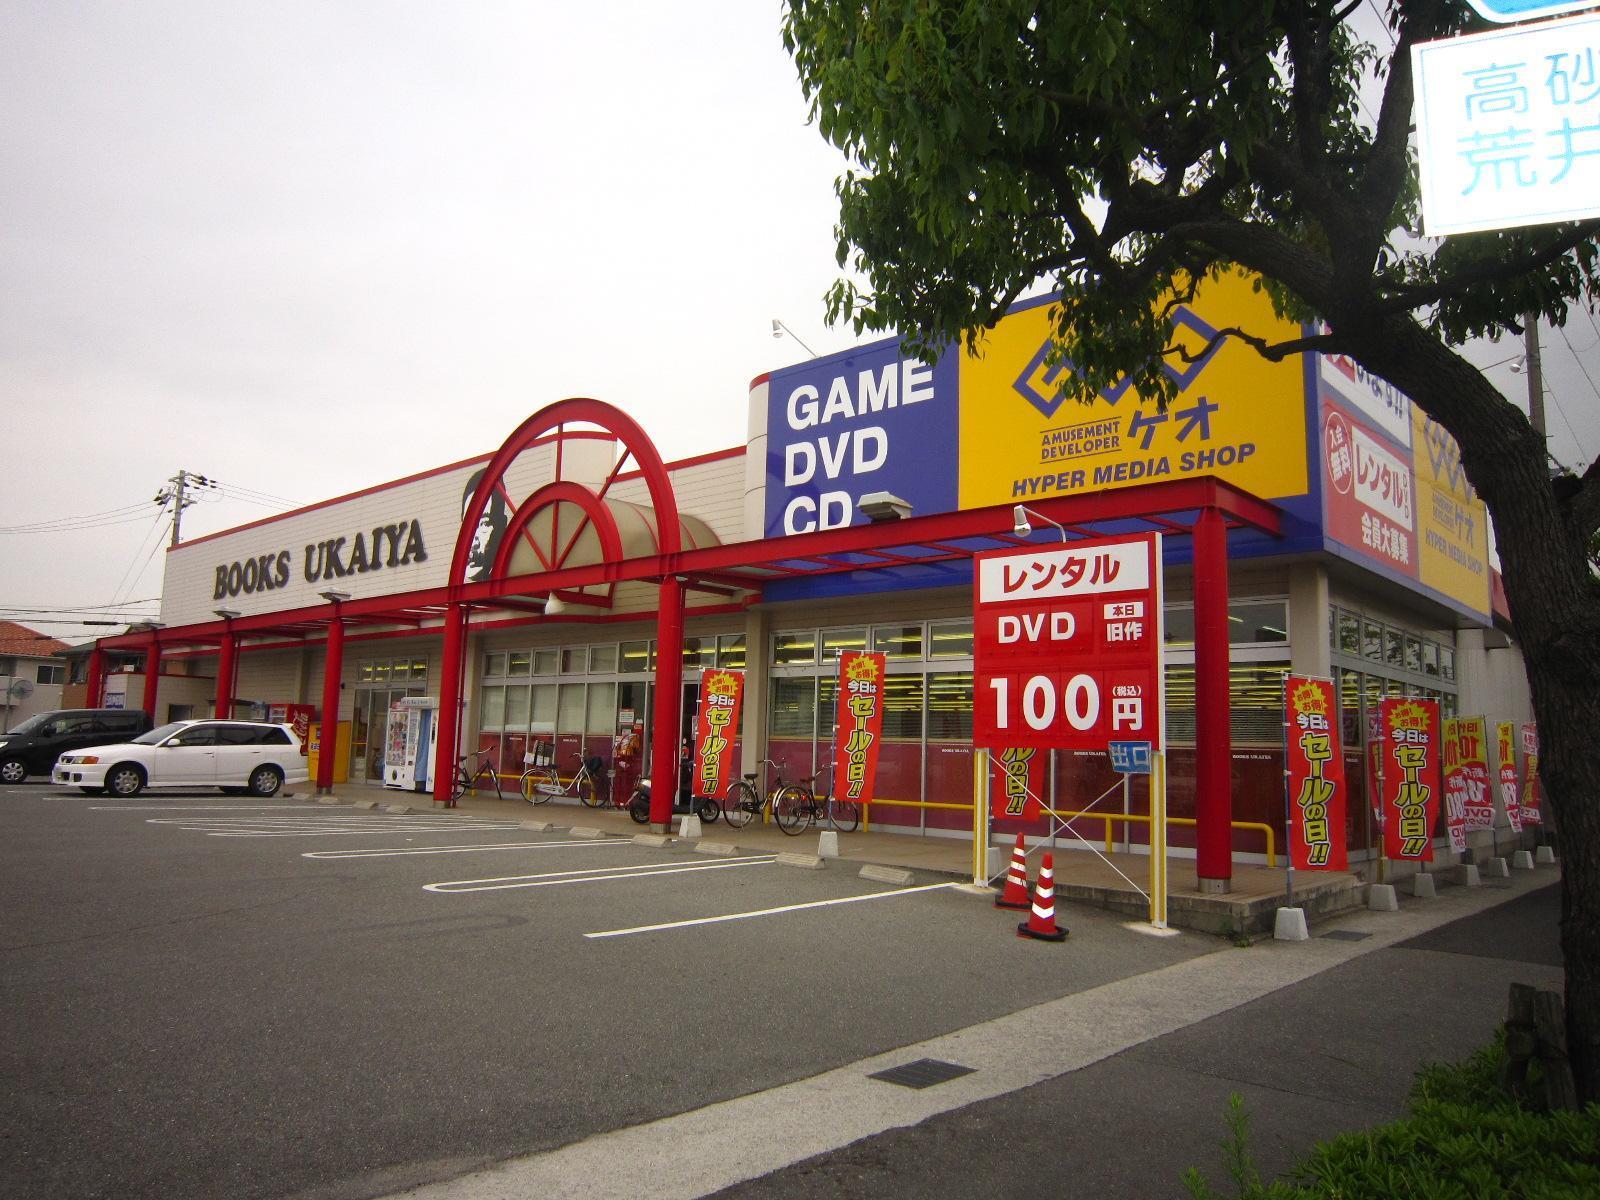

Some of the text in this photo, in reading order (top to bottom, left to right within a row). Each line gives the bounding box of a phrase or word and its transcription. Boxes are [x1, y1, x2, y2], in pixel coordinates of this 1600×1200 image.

[1462, 46, 1600, 120] 高砂
[787, 356, 935, 431] GAME
[1041, 420, 1121, 447] AMUSEMENT
[1041, 436, 1121, 460] DEVELOPER
[784, 426, 888, 488] DVD
[1012, 443, 1257, 498] HYPER MEDIA SHOP
[1356, 444, 1403, 509] レンタル
[784, 490, 853, 536] CD
[213, 518, 428, 601] BOOKS UKAIYA
[1361, 511, 1409, 565] 会員大募集
[1003, 553, 1120, 594] レンタル
[998, 612, 1076, 644] DVD
[1107, 621, 1143, 642] 旧作
[1112, 604, 1135, 617] 本日
[708, 694, 735, 706] 今日は
[848, 680, 877, 693] 今日は
[989, 674, 1100, 731] 100
[1111, 685, 1142, 697] (税込)
[1112, 697, 1143, 731] 円
[1297, 712, 1329, 730] 今日は
[1391, 728, 1428, 743] 今日は
[700, 706, 732, 795] セールの日!!
[844, 694, 876, 798] セールの日!!
[1111, 744, 1150, 767] 出口
[1296, 731, 1335, 866] セールの日!!
[1392, 743, 1430, 856] セールの日!!
